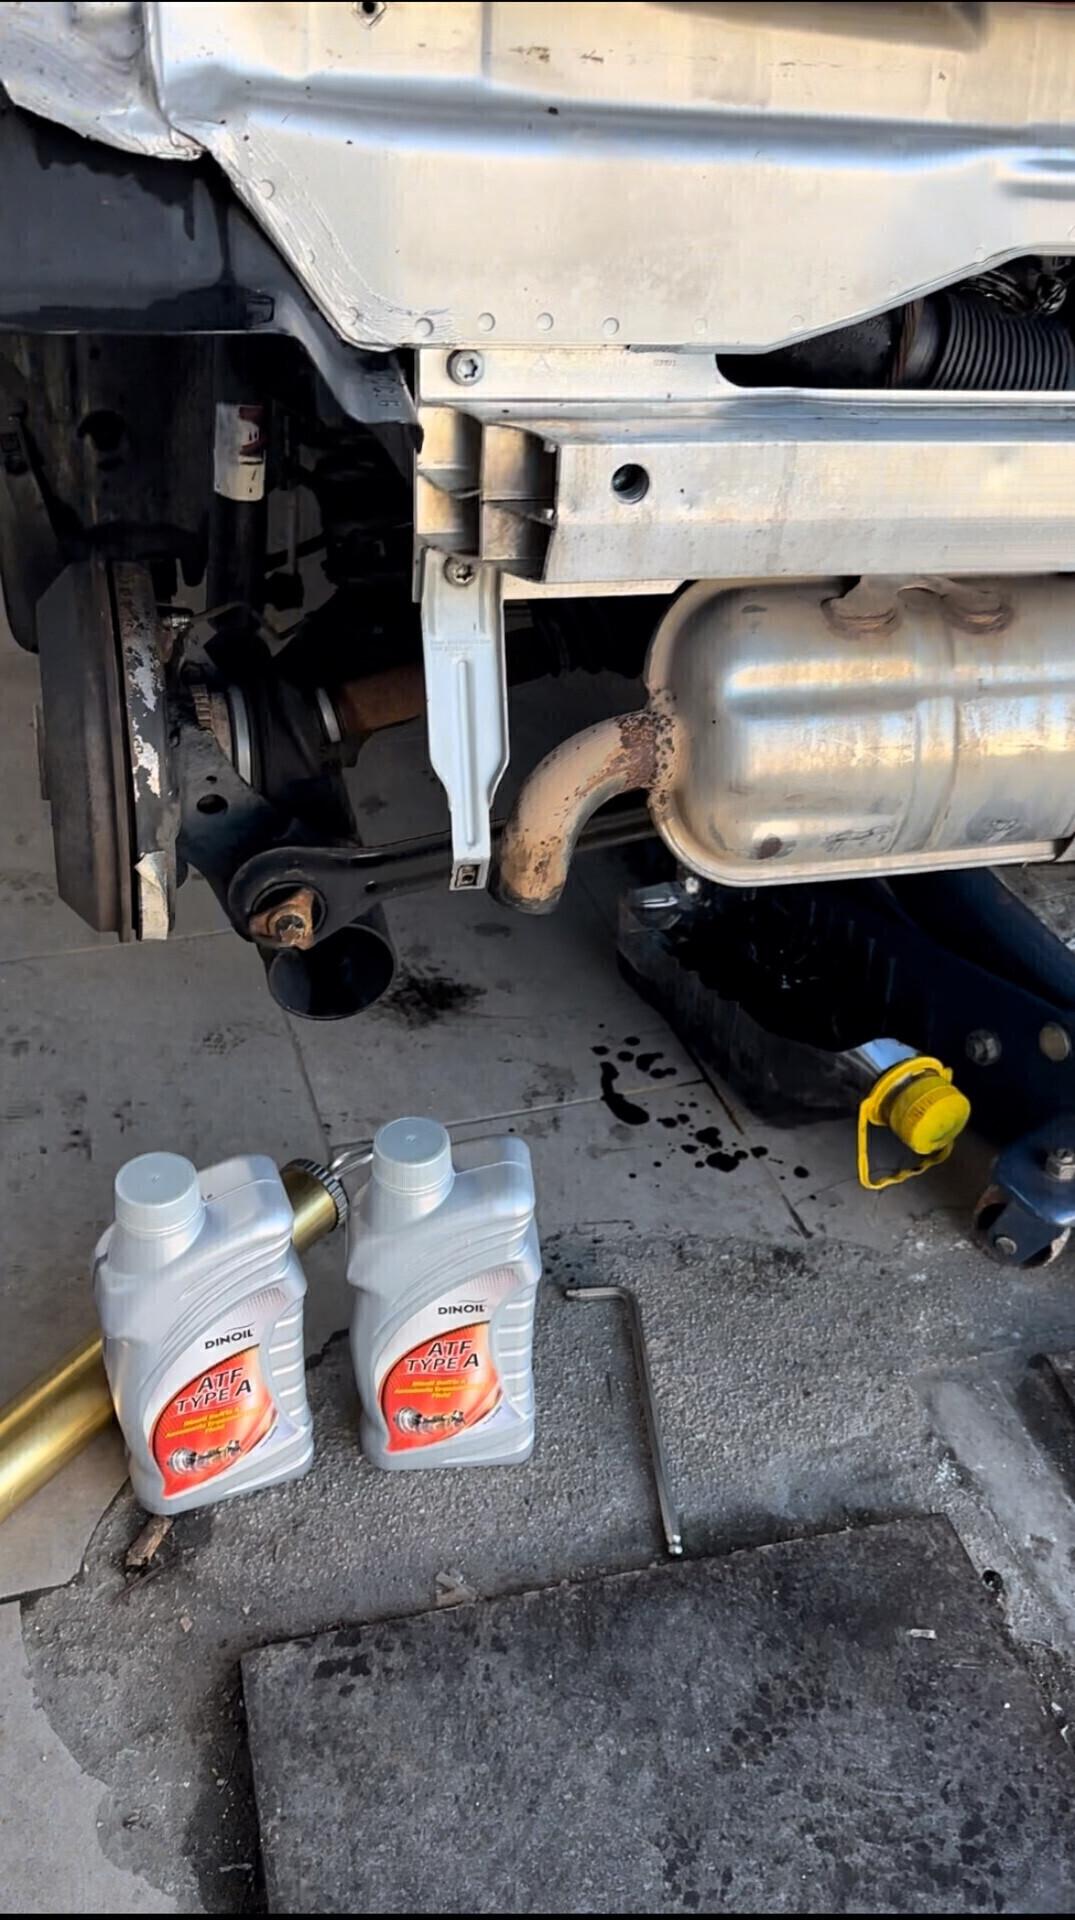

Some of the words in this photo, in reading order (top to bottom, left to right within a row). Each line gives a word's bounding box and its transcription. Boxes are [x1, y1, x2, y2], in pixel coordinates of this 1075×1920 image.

[438, 1304, 484, 1315] DINOIL
[204, 1329, 253, 1349] DINOIL
[428, 1341, 472, 1356] ATF
[407, 1358, 458, 1371] TYPE
[464, 1353, 479, 1368] A
[198, 1367, 243, 1393] ATF
[177, 1387, 229, 1412] TYPE
[236, 1380, 251, 1396] A
